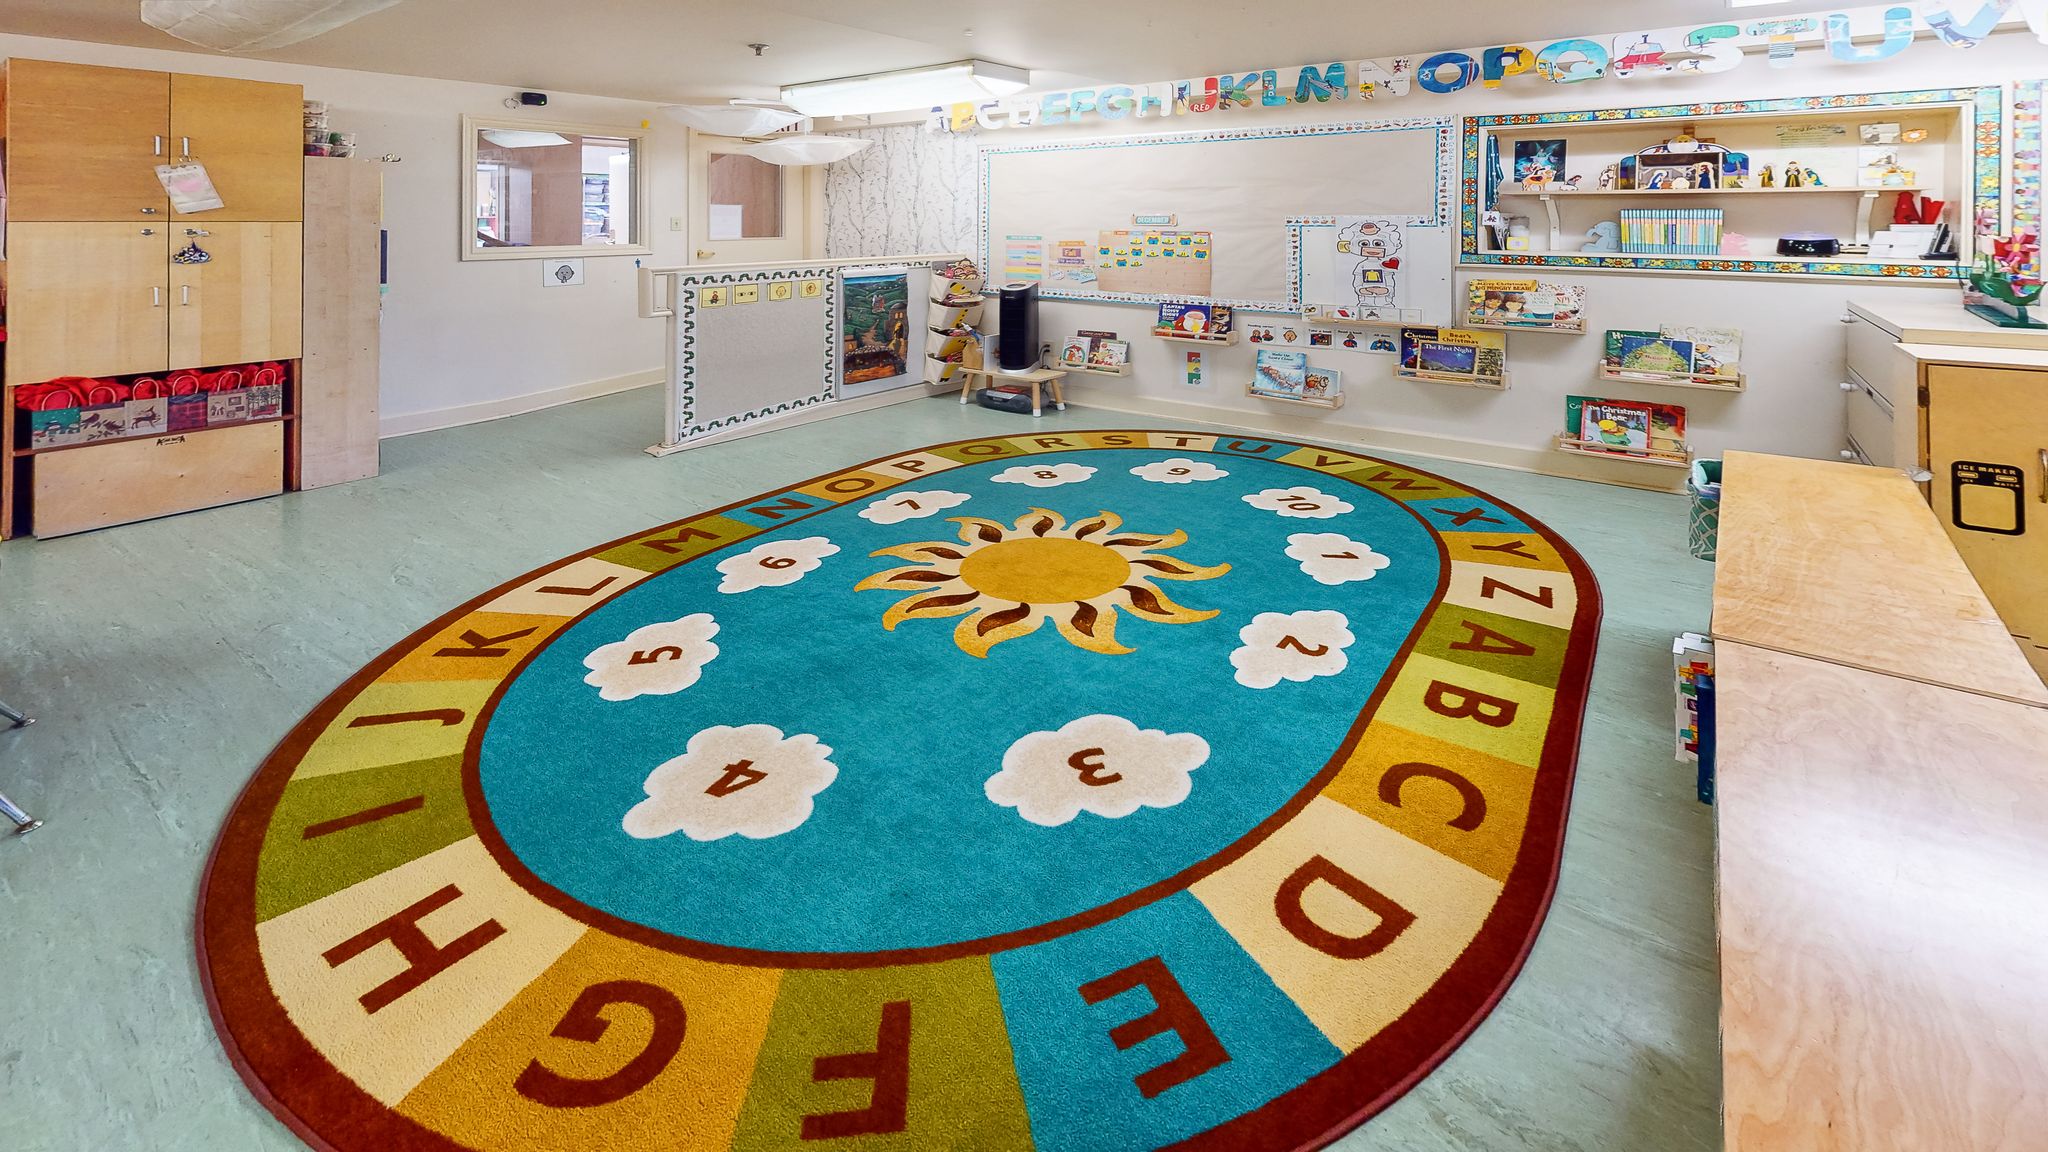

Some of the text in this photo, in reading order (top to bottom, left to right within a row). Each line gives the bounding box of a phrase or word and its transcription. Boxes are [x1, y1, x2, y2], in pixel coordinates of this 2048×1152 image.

[924, 106, 950, 134] A
[951, 102, 975, 132] B
[1009, 96, 1040, 128] D
[1042, 92, 1068, 125] E
[1068, 90, 1096, 121] F
[1096, 86, 1134, 120] G
[1135, 82, 1173, 118] H
[1190, 77, 1218, 112] J
[1218, 72, 1260, 110] K
[1262, 70, 1289, 106] L
[1294, 62, 1348, 102] M
[1358, 56, 1412, 100] N
[1418, 52, 1480, 94] O
[1482, 45, 1536, 90] P
[1536, 38, 1609, 84] Q
[1677, 24, 1744, 74] S
[1746, 16, 1818, 69] T
[1824, 6, 1914, 64] U
[1918, 0, 2012, 49] V
[1193, 103, 1210, 112] RED
[1136, 216, 1170, 224] DECEMBER
[1404, 332, 1437, 340] Christmas
[1442, 337, 1479, 345] Christmas
[1453, 346, 1473, 354] Night
[1601, 405, 1646, 417] Christmas
[1605, 412, 1628, 422] Bear
[1033, 470, 1059, 480] 8
[1166, 467, 1192, 476] 9
[1978, 466, 2017, 475] MAKER
[894, 499, 923, 511] 7
[1276, 494, 1321, 512] 10
[1321, 551, 1360, 561] 1
[758, 554, 797, 570] 6
[1276, 634, 1330, 657] 2
[627, 645, 684, 666] 5
[1066, 747, 1124, 787] 3
[703, 757, 768, 799] 4
[302, 435, 1554, 1141] A B C D E F G H I J K L M N O P Q R S T U V W X Y Z
